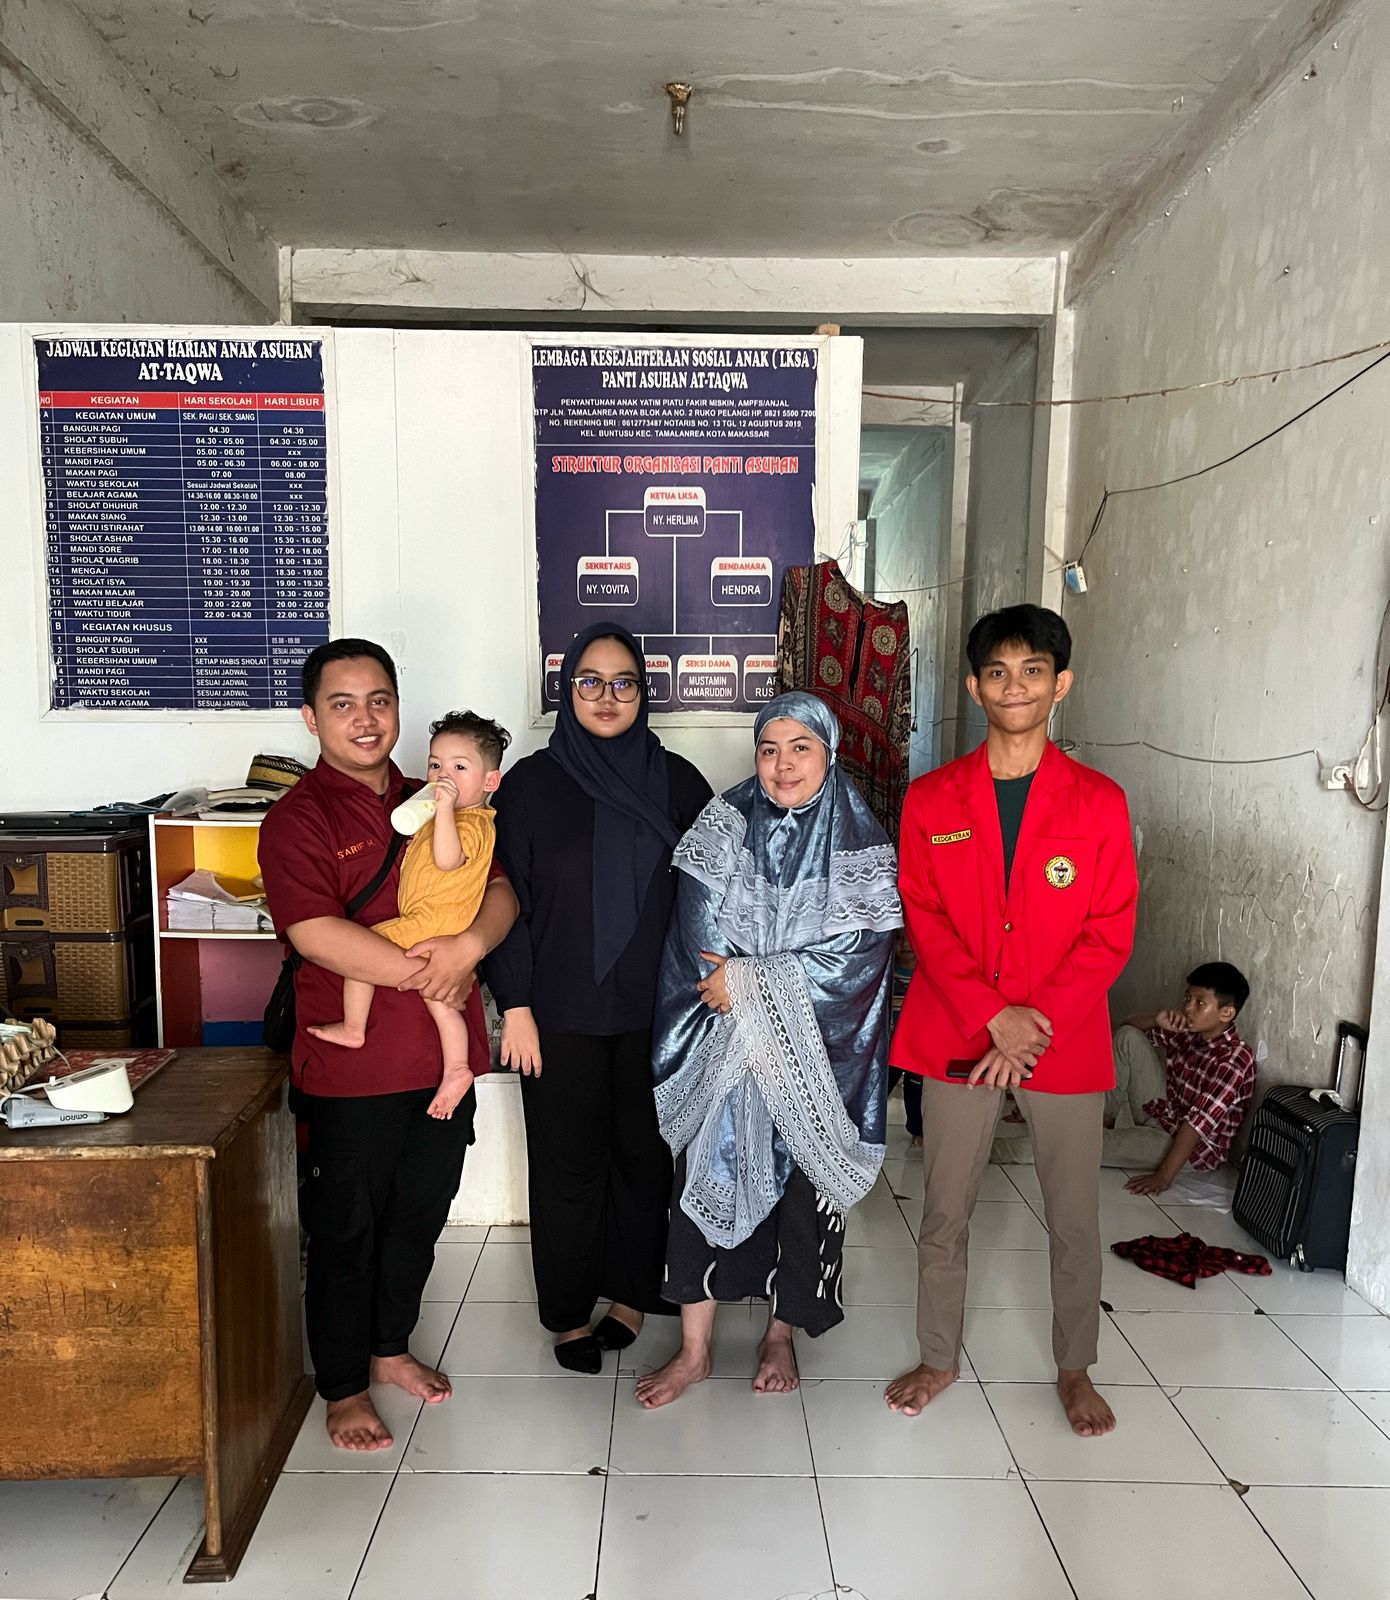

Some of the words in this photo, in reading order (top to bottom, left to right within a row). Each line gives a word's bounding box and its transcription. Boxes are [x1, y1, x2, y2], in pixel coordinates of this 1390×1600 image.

[46, 340, 98, 357] JADWAL
[101, 340, 164, 359] KEGIATAN
[168, 340, 216, 358] HARIAN
[219, 340, 259, 358] ANAK
[260, 340, 313, 358] ASUHAN
[534, 350, 588, 366] LEMBAGA
[590, 349, 689, 366] KESEJAHTERAAN
[692, 349, 732, 367] SOSIAL
[735, 351, 769, 367] ANAK
[780, 349, 811, 367] LKSA
[138, 363, 223, 384] AT-TAQWA
[602, 372, 636, 388] PANTI
[639, 372, 687, 388] ASUHAN
[690, 372, 748, 392] AT-TAQWA
[40, 397, 50, 405] NO
[552, 456, 622, 474] STRUKTUR
[624, 456, 701, 475] ORGANISASI
[703, 456, 742, 475] PANTI
[745, 457, 798, 475] ASUHAN
[653, 515, 664, 524] NY.
[667, 515, 698, 525] HERLINA
[587, 585, 598, 594] NY.
[601, 584, 629, 594] YOVITA
[722, 585, 760, 594] HENDRA
[74, 598, 103, 606] WAKTU
[689, 676, 726, 685] MUSTAMIN
[684, 688, 732, 697] KAMARUDDIN
[934, 832, 970, 842] KEDOKTERAN
